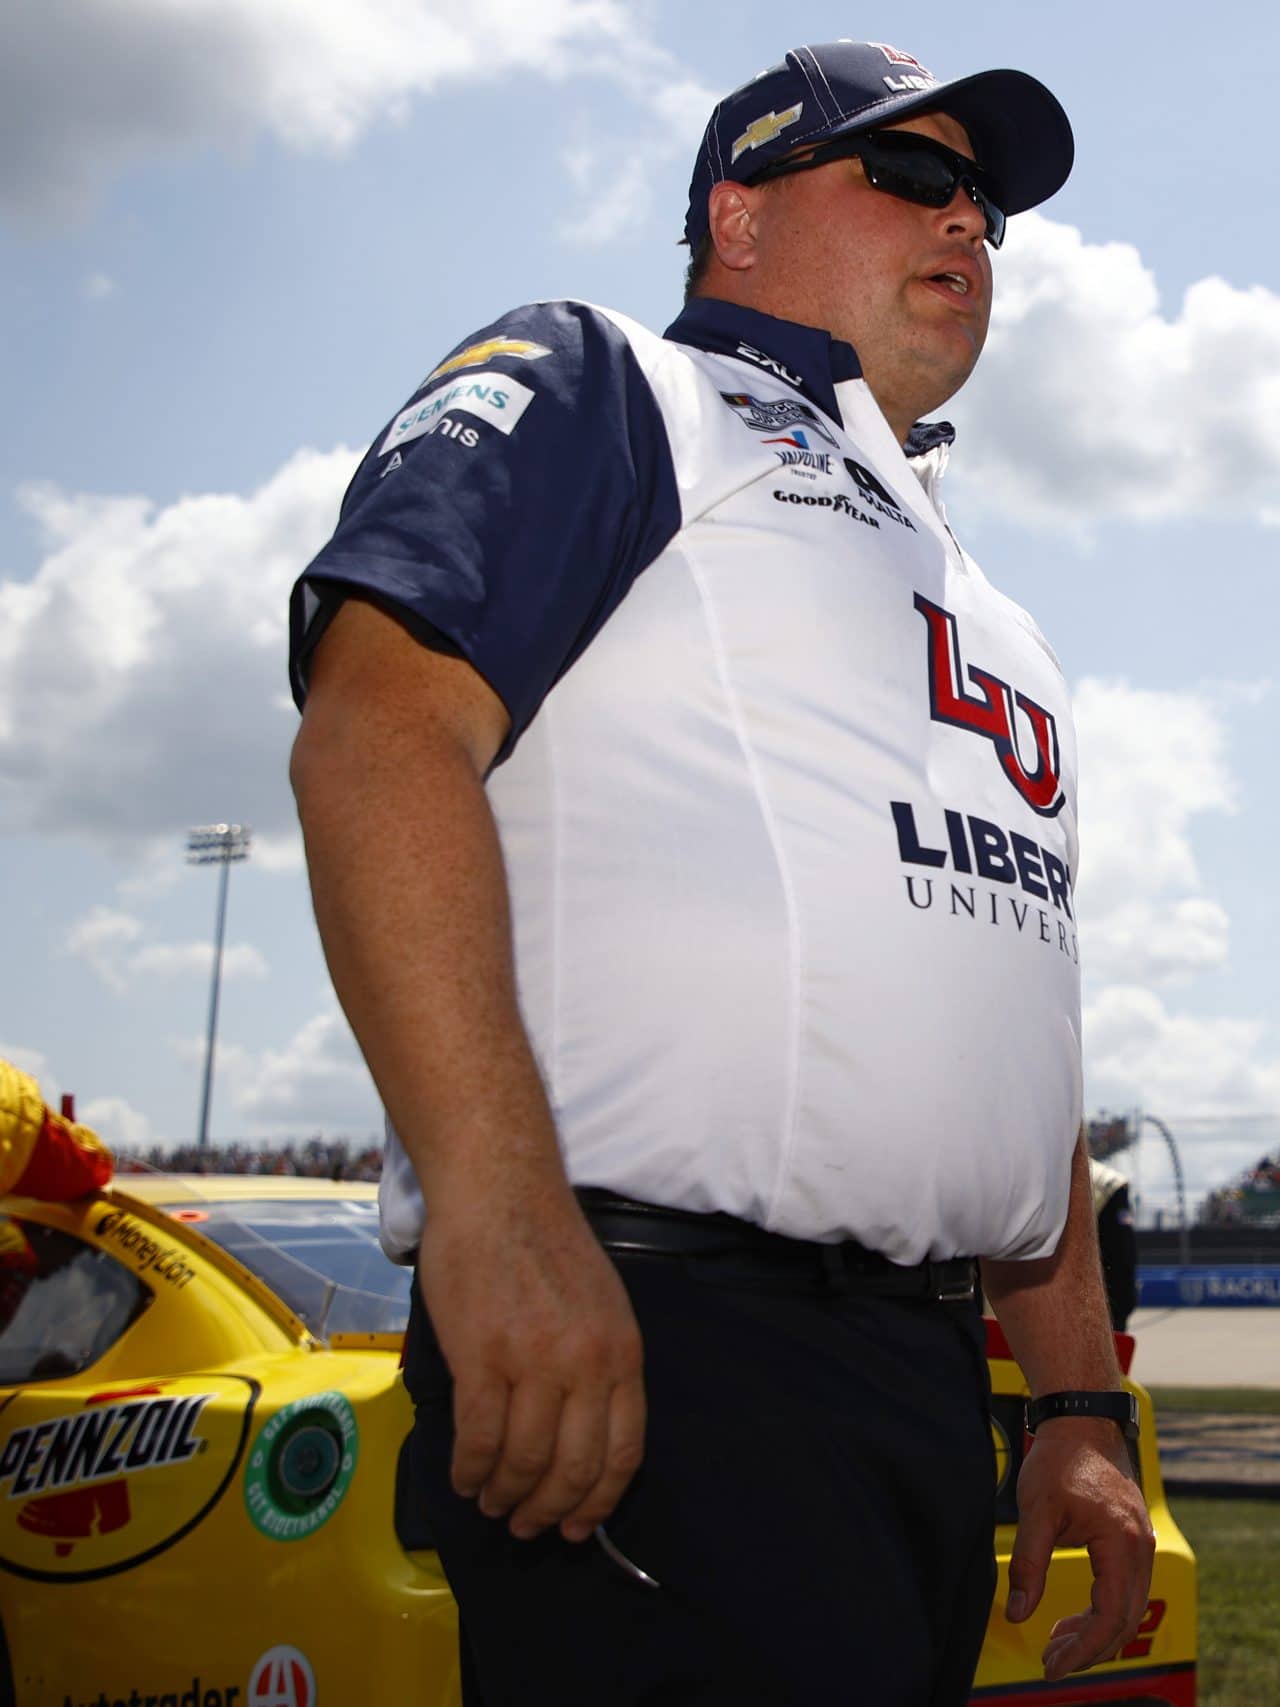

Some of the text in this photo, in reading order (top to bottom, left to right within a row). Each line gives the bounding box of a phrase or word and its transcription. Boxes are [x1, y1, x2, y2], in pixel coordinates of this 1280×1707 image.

[396, 384, 509, 436] SIEMENS
[773, 490, 881, 530] GOODYEAR
[914, 591, 1067, 818] LU
[0, 1395, 211, 1497] PENNZOIL
